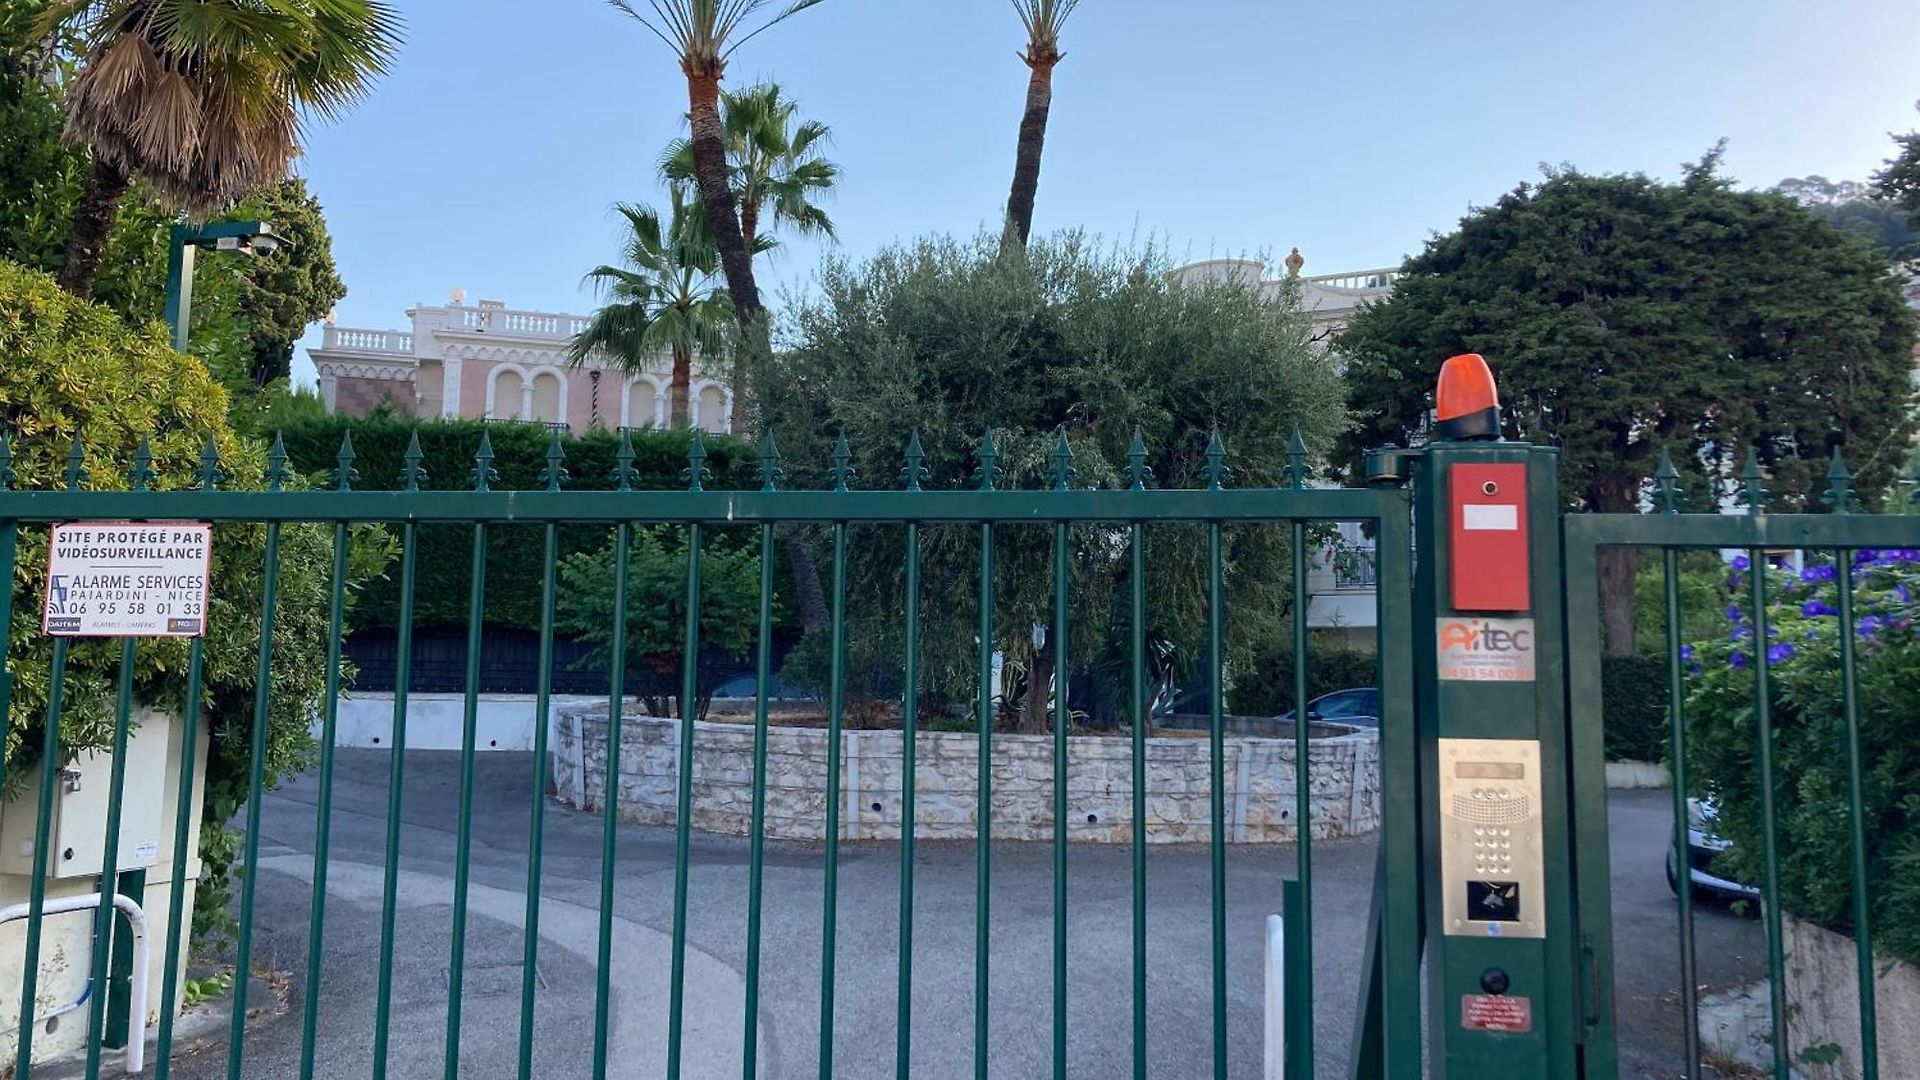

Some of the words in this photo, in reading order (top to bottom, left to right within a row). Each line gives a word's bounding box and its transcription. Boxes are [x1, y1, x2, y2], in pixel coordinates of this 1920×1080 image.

[58, 531, 91, 543] SITE
[97, 529, 167, 543] PROTÉGÉ
[173, 532, 203, 543] PAR
[57, 545, 202, 559] VIDÉOSURVEILLANCE
[72, 575, 131, 589] ALARME
[137, 575, 203, 589] SERVICES
[70, 590, 147, 600] PAIARDINI
[168, 591, 202, 601] NICE
[69, 602, 87, 615] 06
[99, 602, 116, 615] 95
[127, 602, 145, 615] 58
[156, 602, 172, 615] 01
[183, 603, 201, 615] 33
